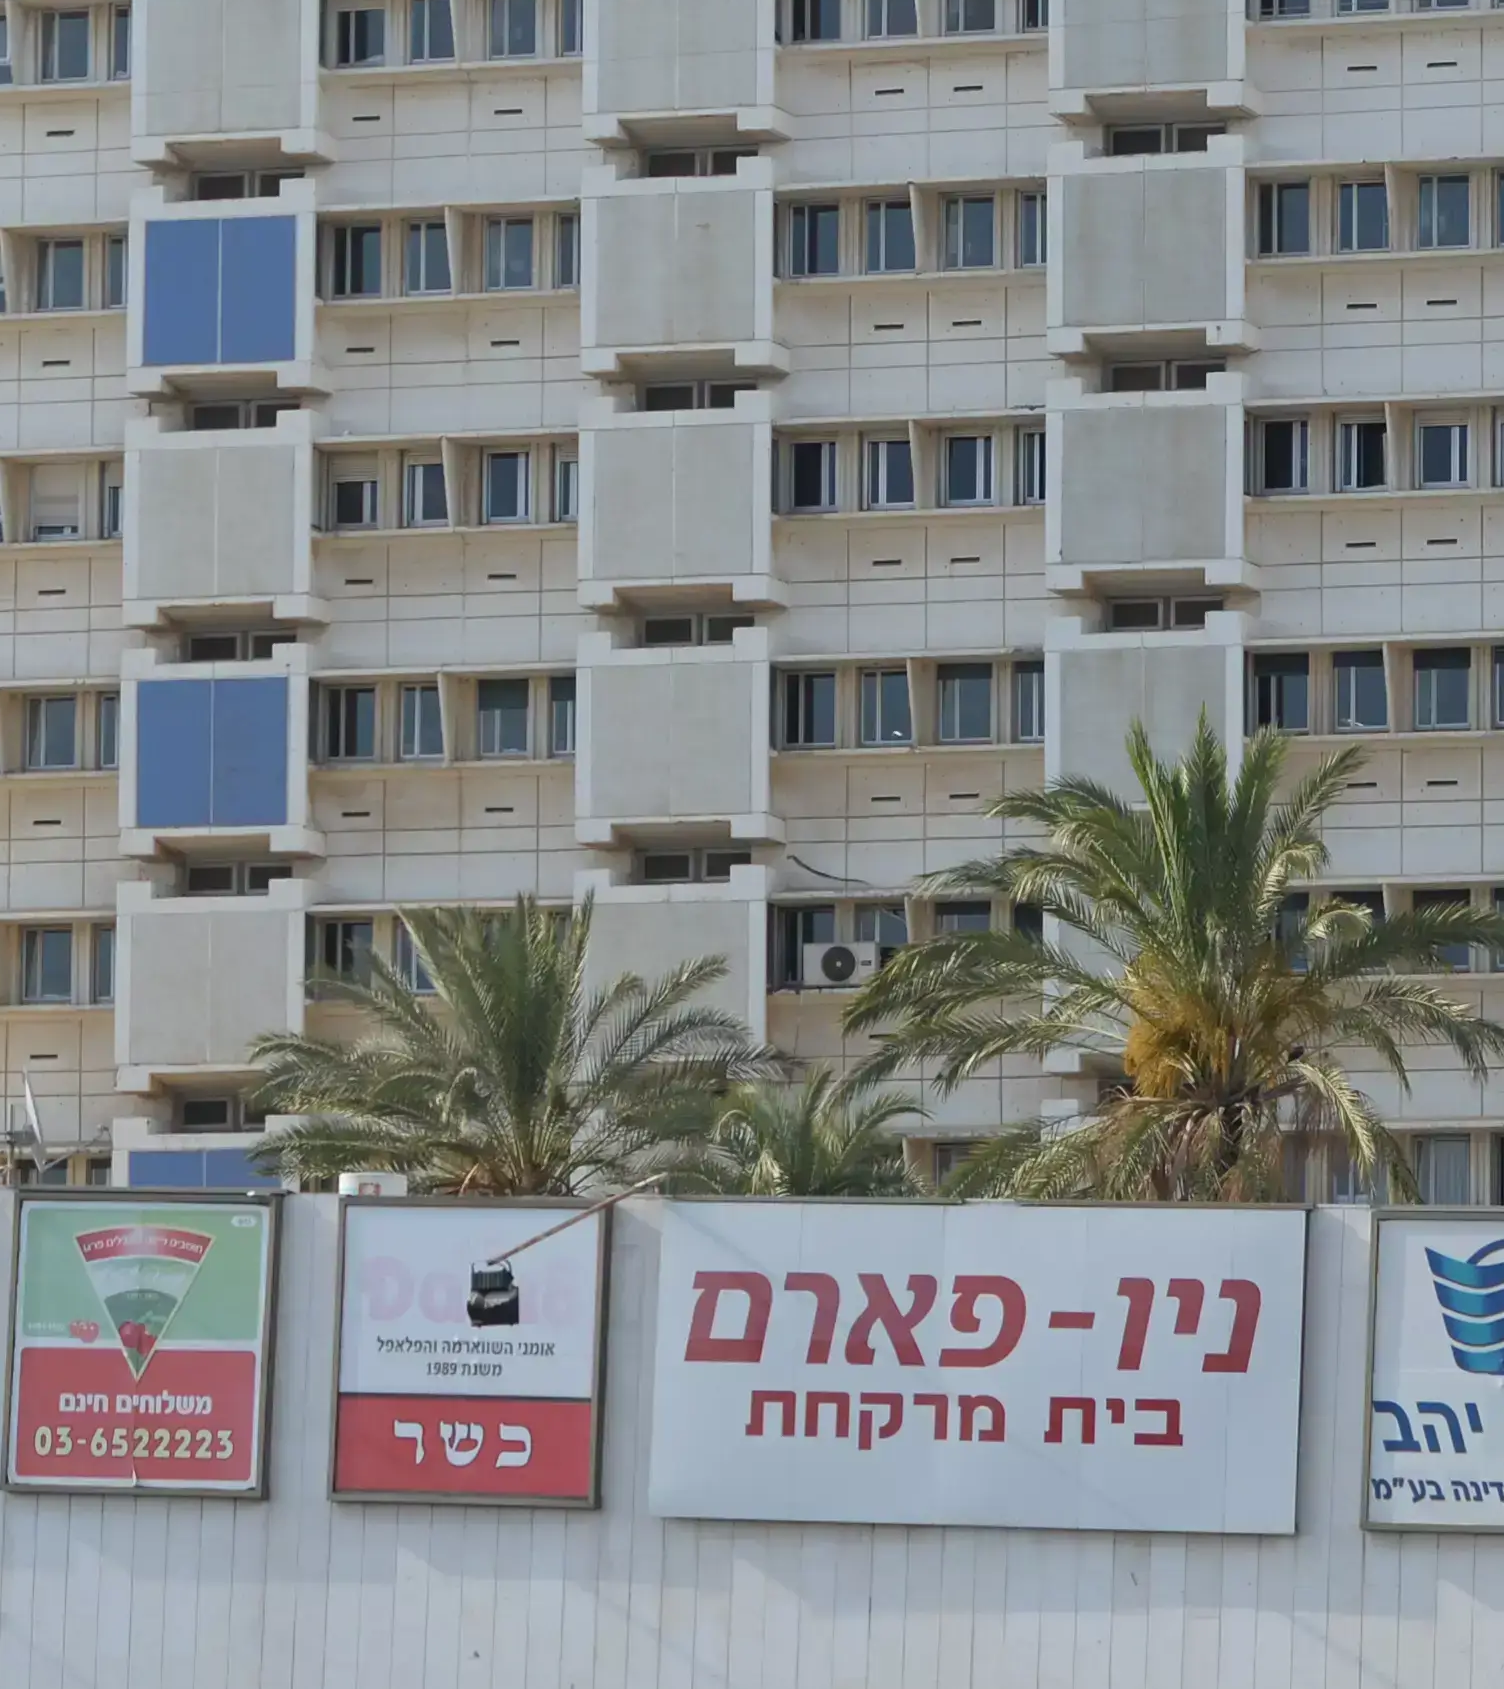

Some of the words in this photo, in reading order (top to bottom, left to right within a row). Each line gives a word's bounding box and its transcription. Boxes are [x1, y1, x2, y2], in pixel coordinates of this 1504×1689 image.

[377, 1336, 437, 1354] והפלאפל
[442, 1339, 513, 1355] השווארמה
[518, 1341, 555, 1356] אומני
[426, 1362, 457, 1376] 1989
[461, 1363, 503, 1376] משנת
[59, 1391, 109, 1414] חינם
[116, 1391, 213, 1415] משלוחים
[745, 1390, 1006, 1450] מרקחת
[1044, 1396, 1184, 1446] בית
[1372, 1400, 1483, 1454] יהב
[34, 1425, 235, 1461] 03-6522223
[393, 1418, 534, 1469] כשר
[1371, 1478, 1445, 1503] בע"מ
